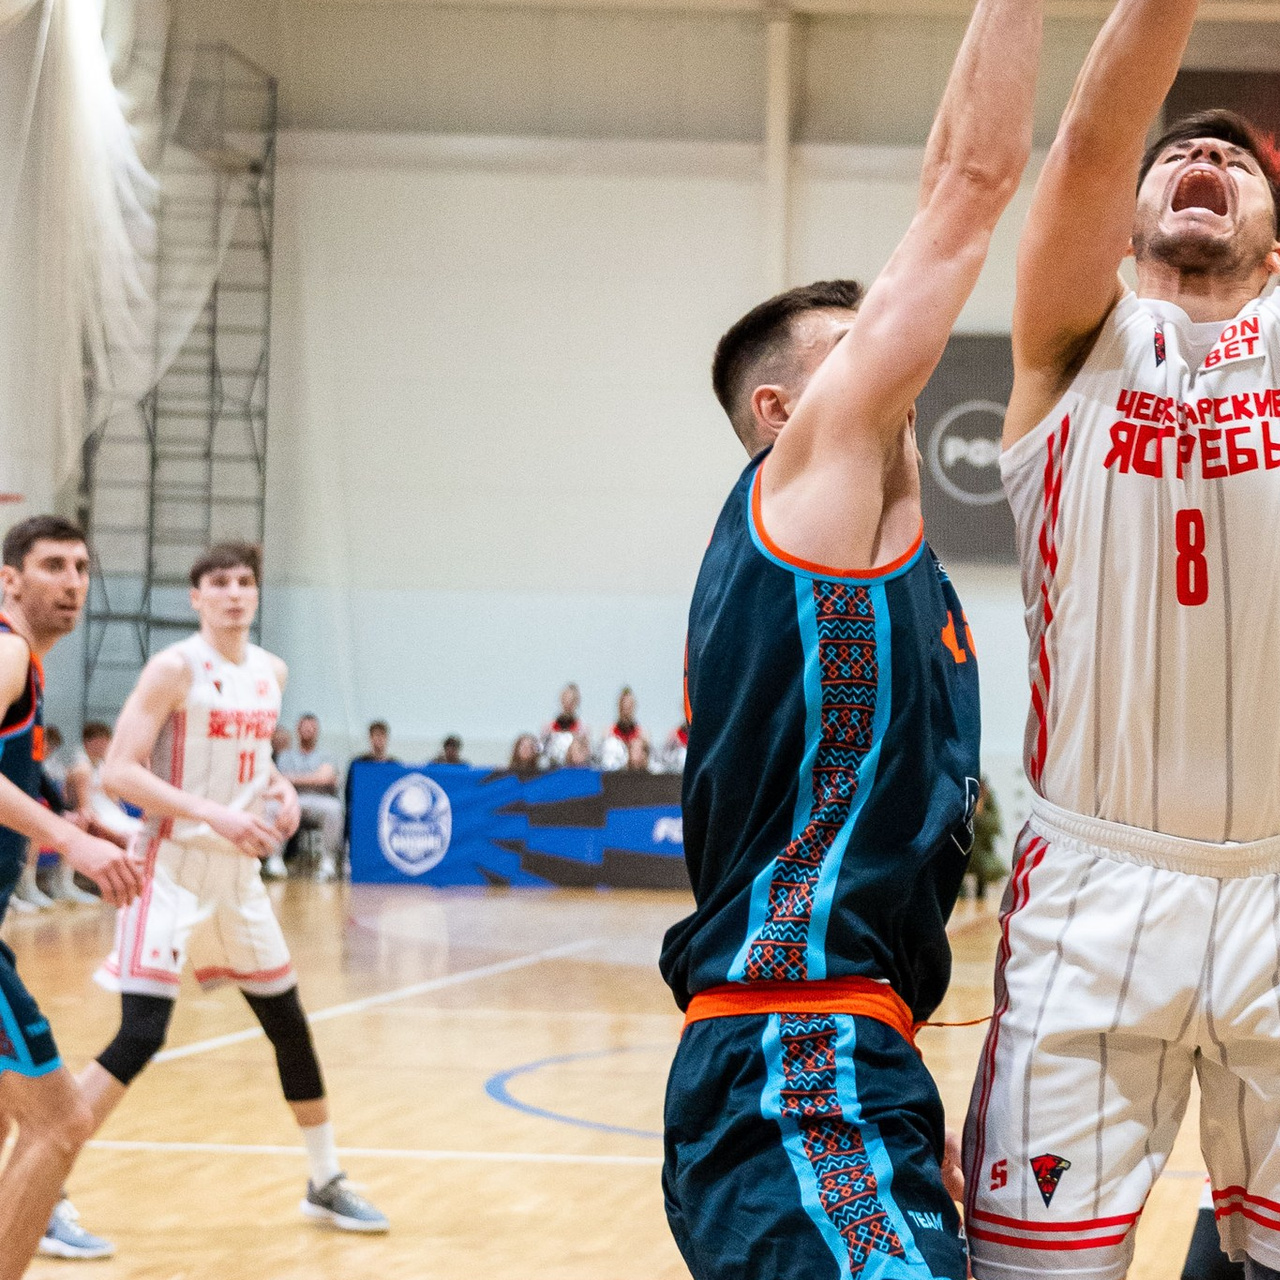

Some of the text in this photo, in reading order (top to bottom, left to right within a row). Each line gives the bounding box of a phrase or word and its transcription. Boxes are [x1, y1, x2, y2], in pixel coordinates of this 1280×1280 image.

[1219, 316, 1260, 344] ON
[1204, 335, 1260, 369] BET
[1175, 508, 1208, 607] 8
[238, 750, 255, 785] 11
[908, 1210, 944, 1231] TEAM
